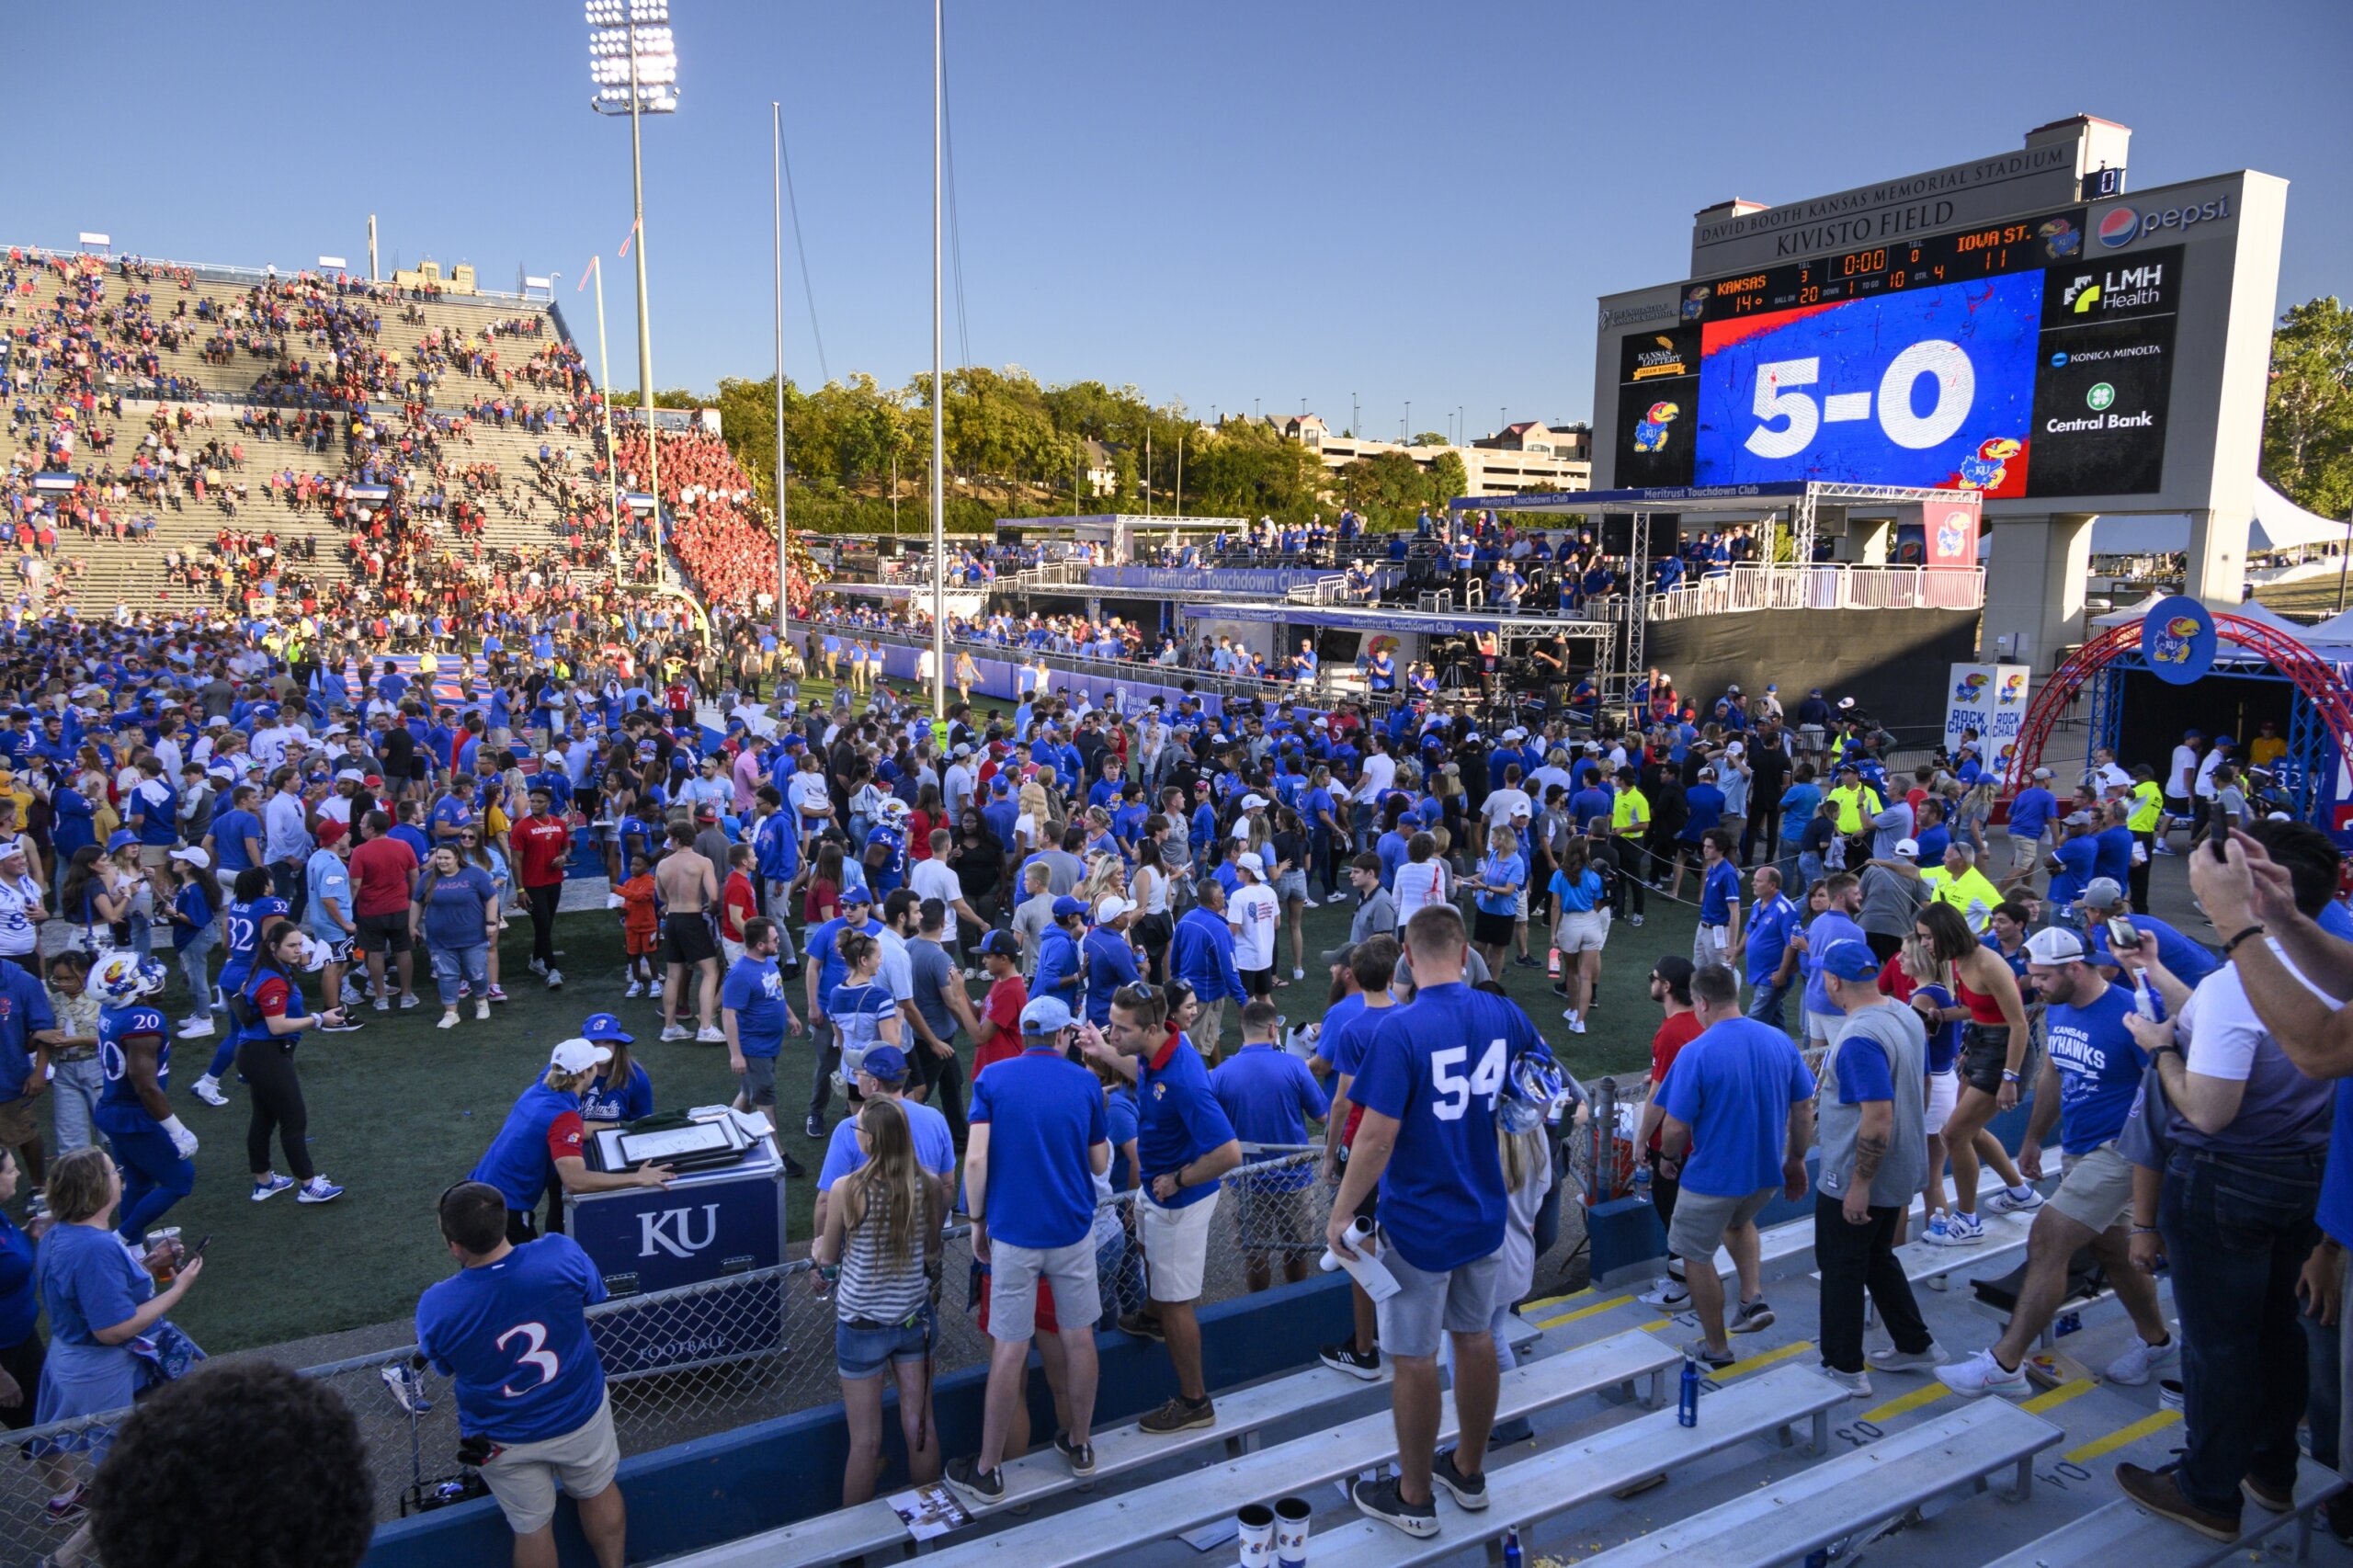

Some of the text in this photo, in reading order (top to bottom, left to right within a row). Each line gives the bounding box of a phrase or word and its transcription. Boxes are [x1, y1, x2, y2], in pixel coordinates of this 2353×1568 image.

[1701, 148, 2063, 242] DAVID BOOTH KANSAS MEMORIAL STADIUM
[2142, 194, 2228, 237] pepsi
[1777, 200, 1954, 256] KIVISTO FIELD
[1956, 225, 2031, 254] IOWA ST.
[1844, 248, 1885, 276] 0:00
[1911, 249, 1919, 263] 0
[1985, 248, 2006, 270] 11
[1801, 270, 1809, 283] 3
[1890, 270, 1904, 289] 10
[1933, 264, 1945, 279] 4
[2105, 264, 2163, 292] LMH
[1717, 275, 1767, 296] KANSAS
[1823, 286, 1839, 297] DOWN
[1735, 294, 1751, 313] 14
[1800, 286, 1818, 305] 20
[2103, 288, 2159, 310] Health
[1638, 349, 1672, 361] KANSAS
[1642, 354, 1683, 367] LOTTERY
[2071, 345, 2161, 363] KONICA MINOLTA
[1744, 339, 1976, 460] 5-0
[2047, 411, 2154, 433] Central Bank
[1479, 494, 1569, 507] Meritrust Touchdown Club
[1644, 483, 1759, 500] Meritrust Touchdown Club
[1148, 570, 1310, 592] Meritrust Touchdown Club
[1210, 608, 1287, 622] Meritrust Touchdown Club
[1351, 617, 1455, 633] Meritrust Touchdown Club
[1952, 710, 1985, 724] ROCK
[1996, 711, 2020, 725] ROCK
[1332, 724, 1343, 741] 5
[275, 740, 286, 763] 5
[531, 825, 562, 835] KANSAS
[632, 822, 642, 833] 3
[880, 833, 892, 845] 54
[272, 901, 289, 914] 32
[132, 1013, 160, 1030] 20
[2052, 1026, 2089, 1042] KANSAS
[1431, 1038, 1507, 1121] 54
[636, 1203, 721, 1258] KU
[494, 1322, 559, 1398] 3
